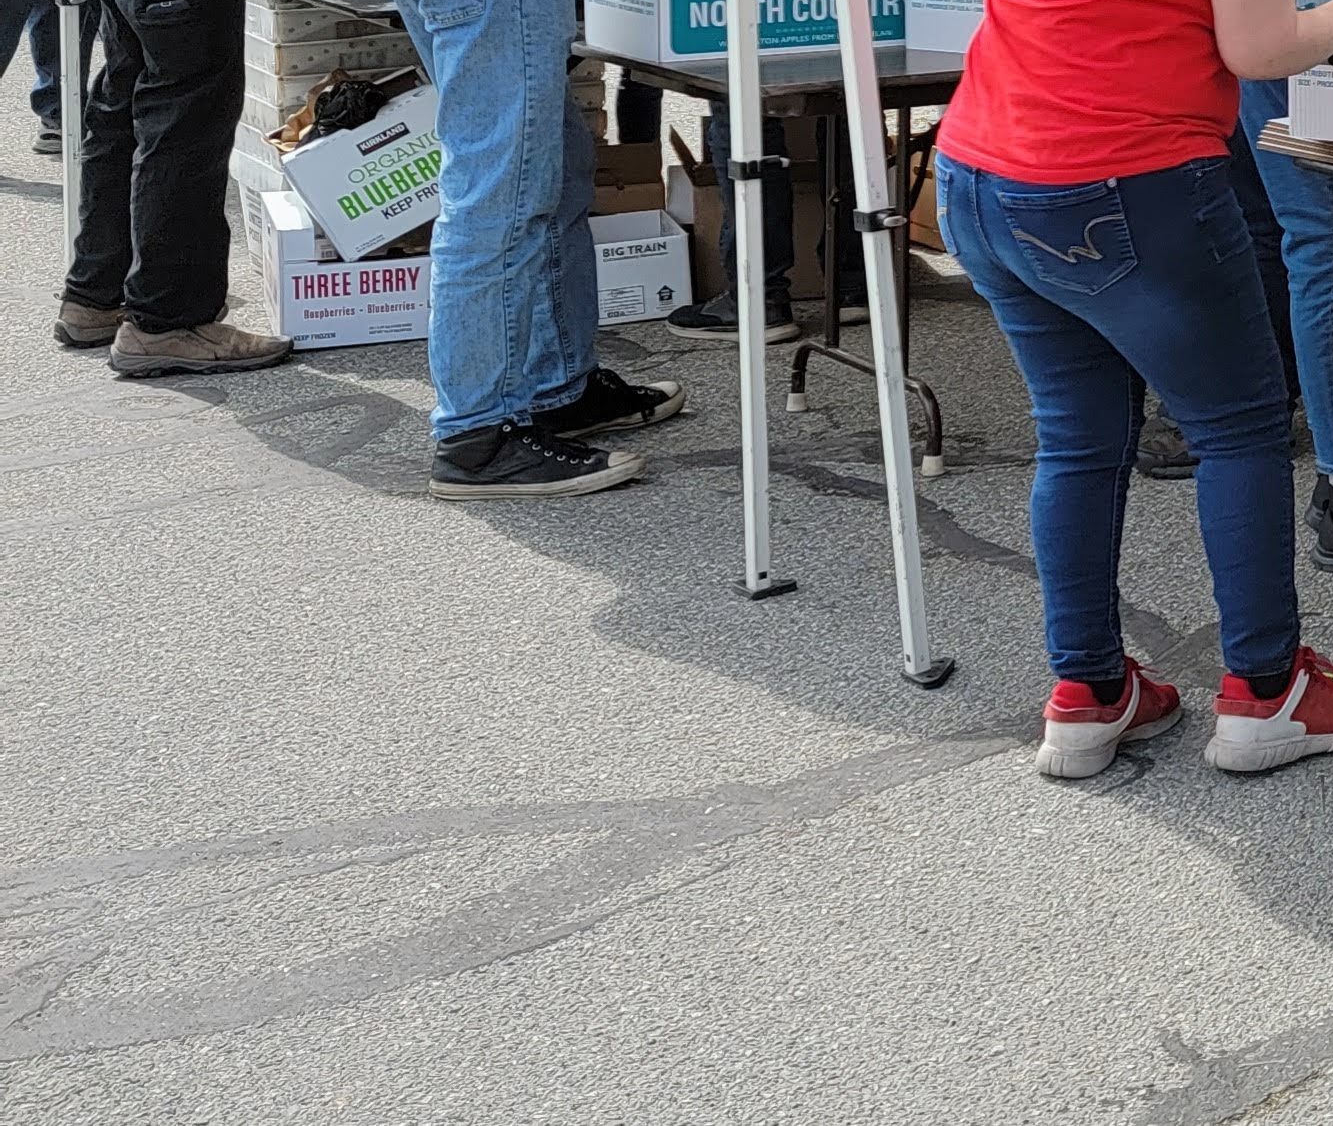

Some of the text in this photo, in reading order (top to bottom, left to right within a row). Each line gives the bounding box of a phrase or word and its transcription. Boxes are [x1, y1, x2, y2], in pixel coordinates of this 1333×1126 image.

[359, 123, 406, 153] KIRKLAND
[337, 148, 443, 221] BLUEBERR
[380, 182, 441, 221] KEEP FRO
[602, 246, 624, 259] BIG
[626, 241, 668, 256] TRAIN
[292, 265, 421, 300] THREE BERRY
[303, 300, 416, 320] Raspberries Blueberries
